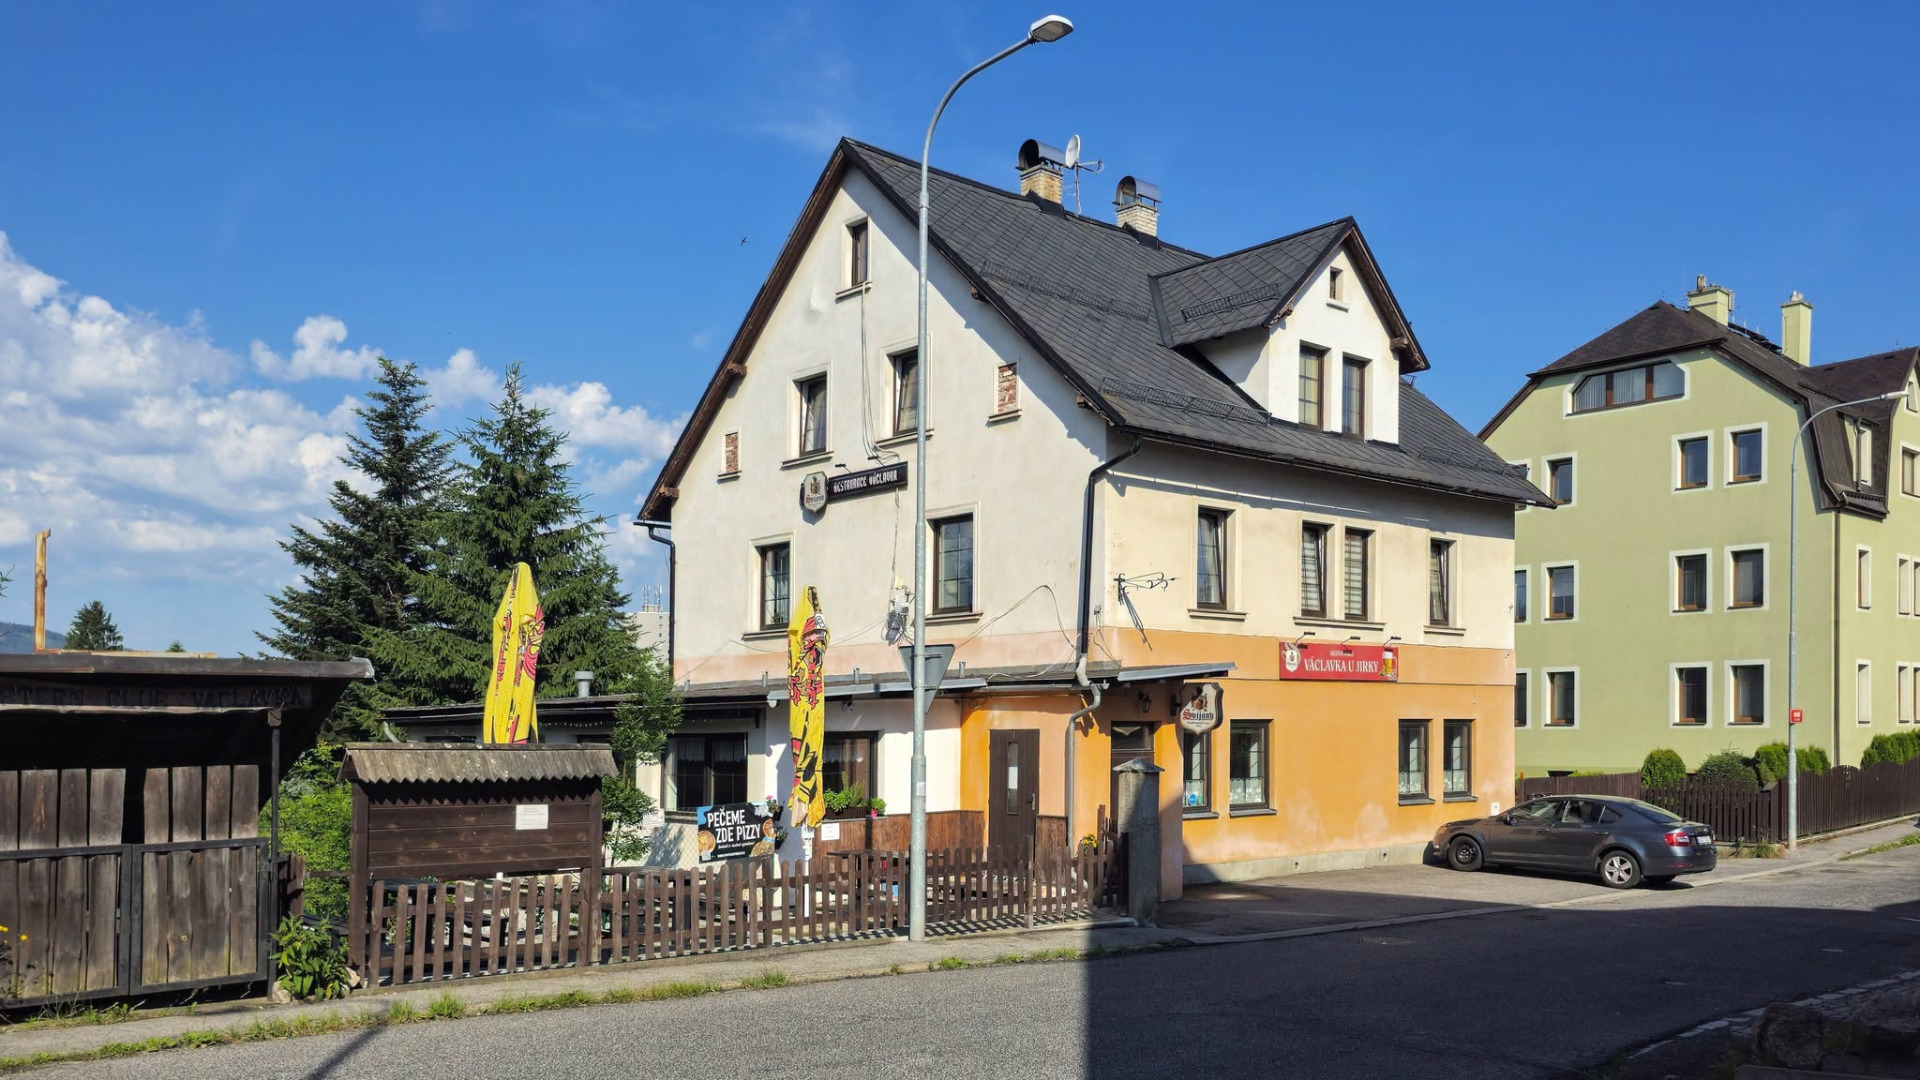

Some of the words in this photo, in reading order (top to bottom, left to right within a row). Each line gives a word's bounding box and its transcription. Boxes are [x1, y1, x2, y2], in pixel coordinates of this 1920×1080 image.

[1304, 656, 1346, 672] VÁCLAVKA
[1348, 660, 1355, 672] U
[1356, 661, 1379, 673] JIRKY
[1183, 709, 1213, 721] Svijany
[707, 807, 746, 828] PEČEME
[716, 826, 734, 843] ZDE
[736, 824, 760, 841] PIZZY
